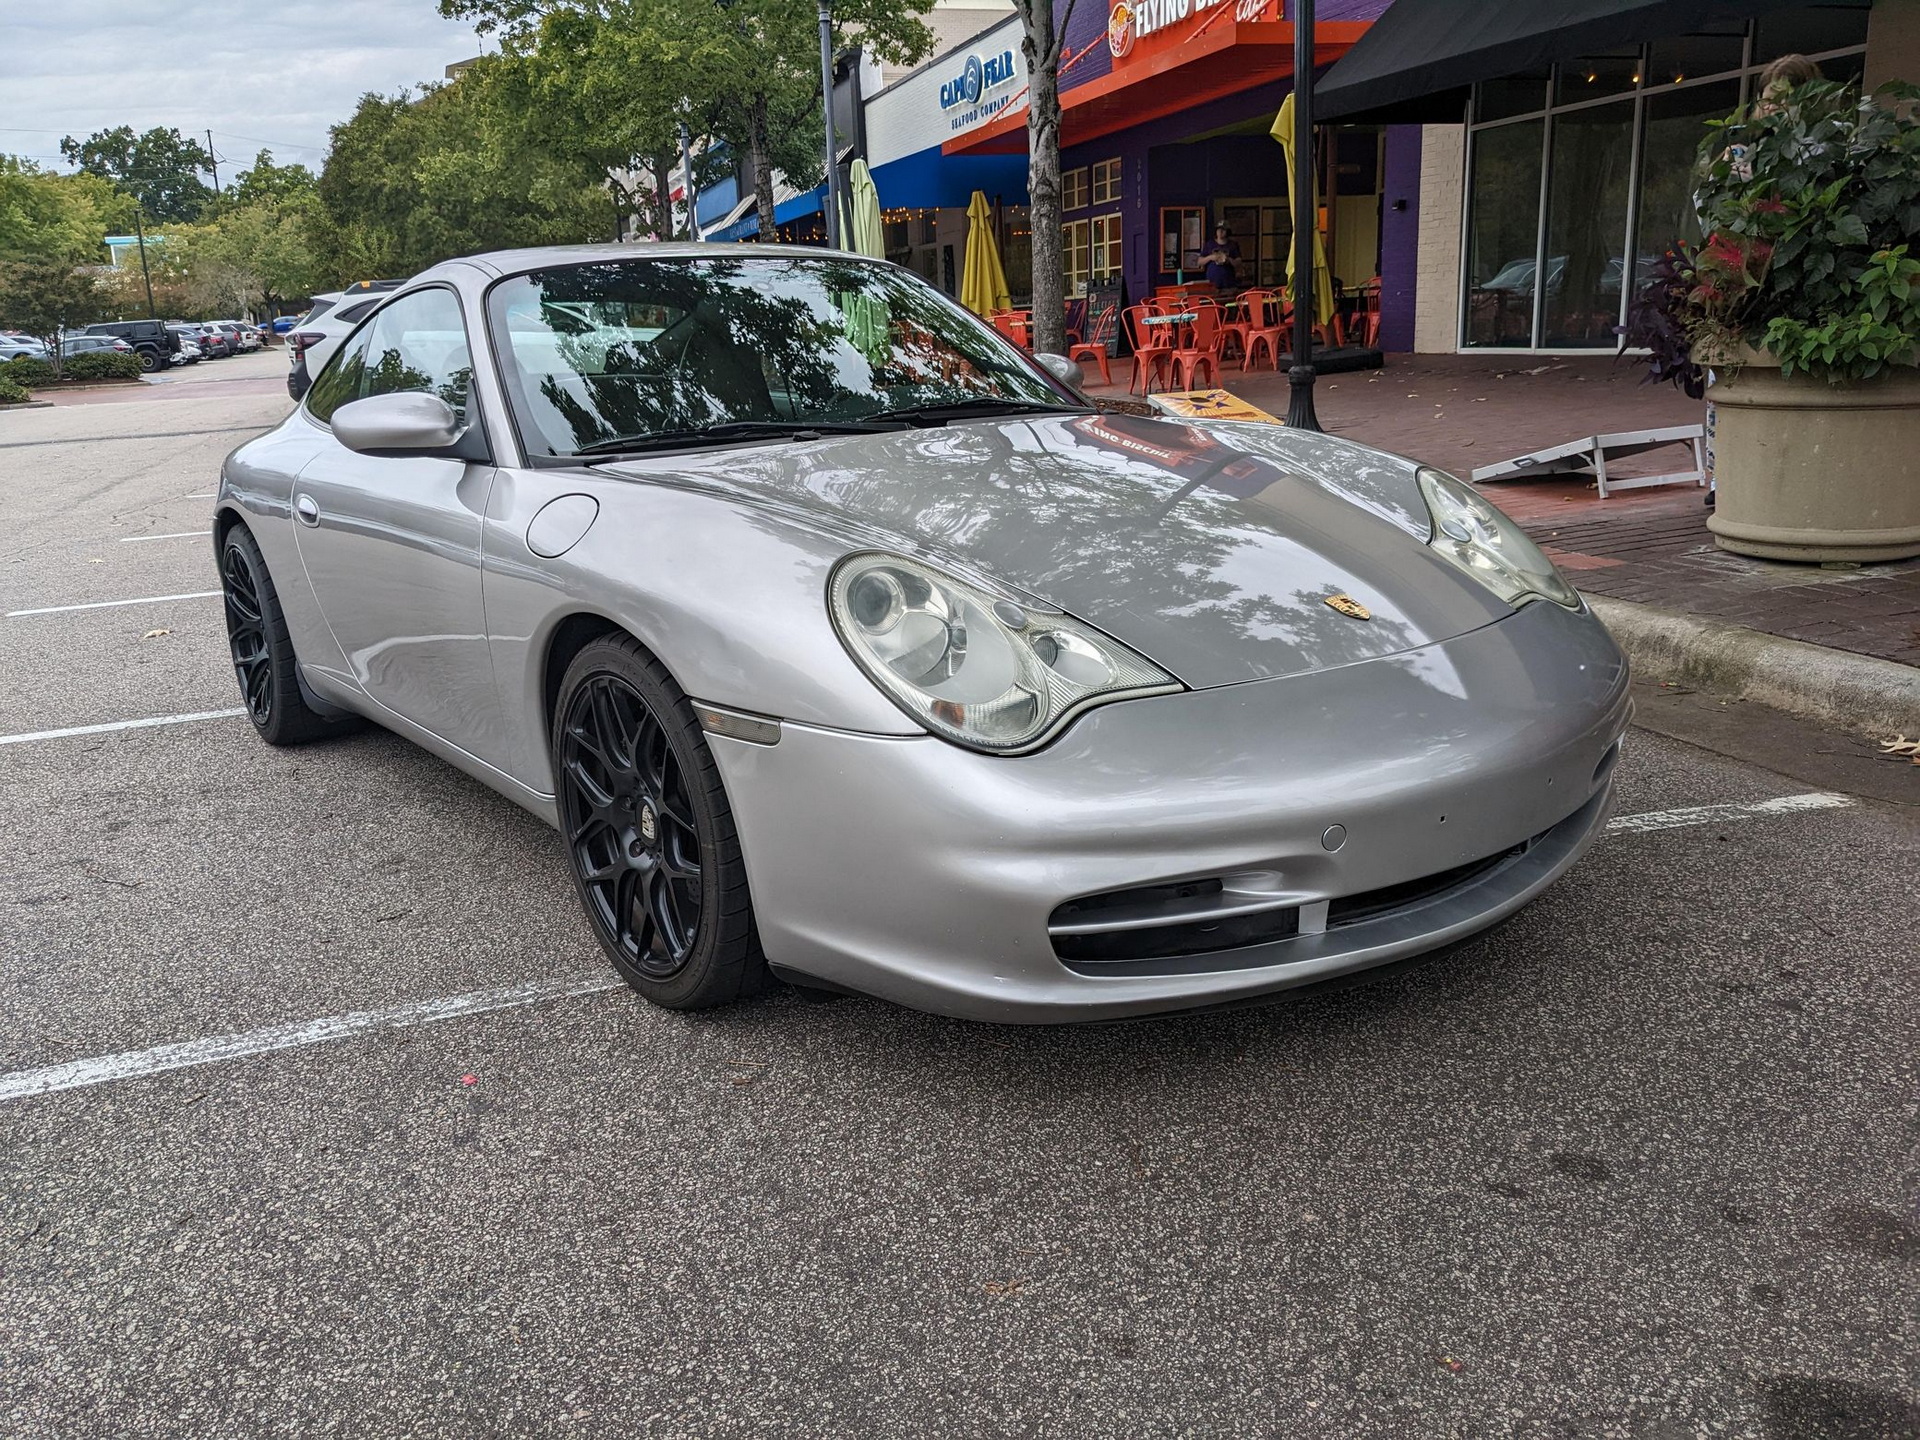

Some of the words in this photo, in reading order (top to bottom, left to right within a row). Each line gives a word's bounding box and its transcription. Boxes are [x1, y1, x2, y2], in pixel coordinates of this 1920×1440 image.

[1136, 0, 1188, 38] FLYING
[983, 51, 1014, 89] FEAR
[951, 109, 978, 130] SEAFOOD
[980, 95, 1009, 117] COMPANY
